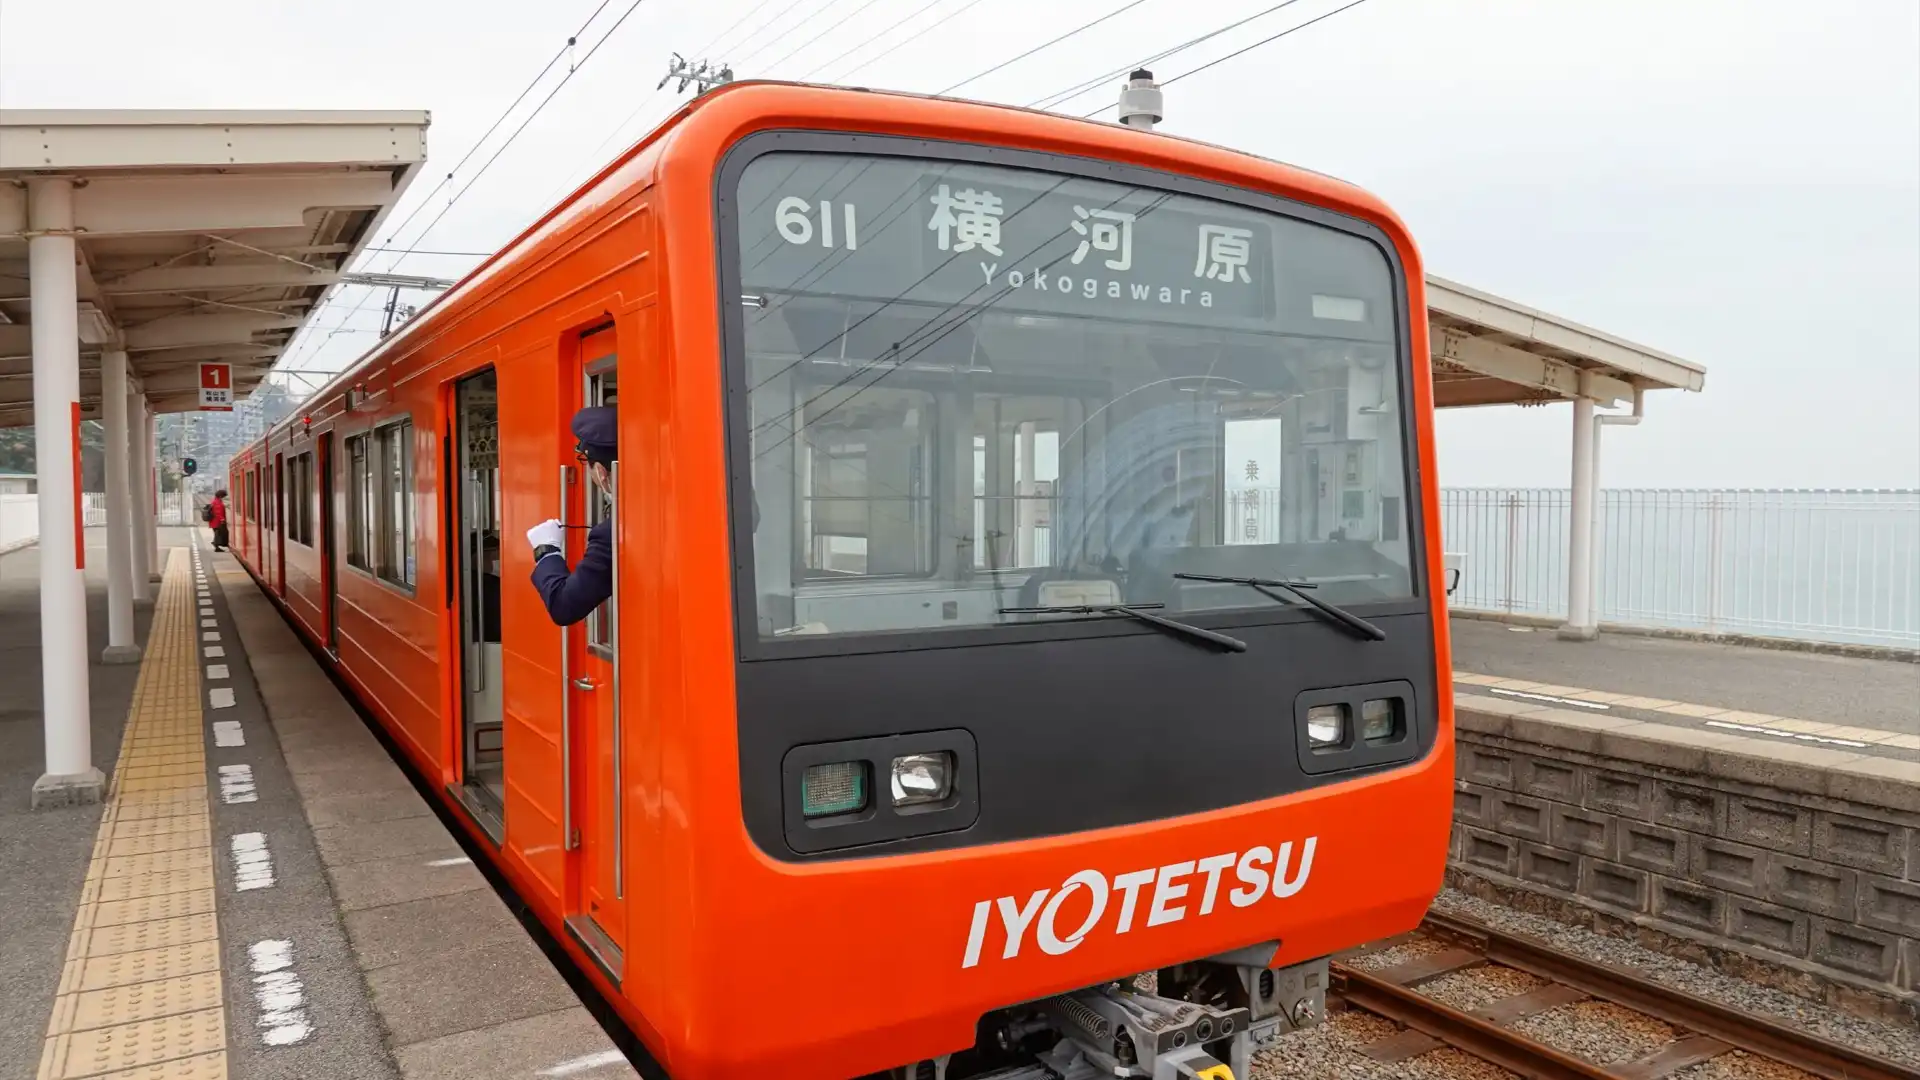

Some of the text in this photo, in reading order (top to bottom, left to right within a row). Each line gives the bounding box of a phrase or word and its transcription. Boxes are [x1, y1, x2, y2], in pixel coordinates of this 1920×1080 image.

[774, 195, 858, 251] 611
[927, 183, 1253, 285] 横河原
[980, 260, 1215, 308] Yokogawara
[209, 369, 220, 385] 1
[961, 836, 1319, 970] IYOTETSU
